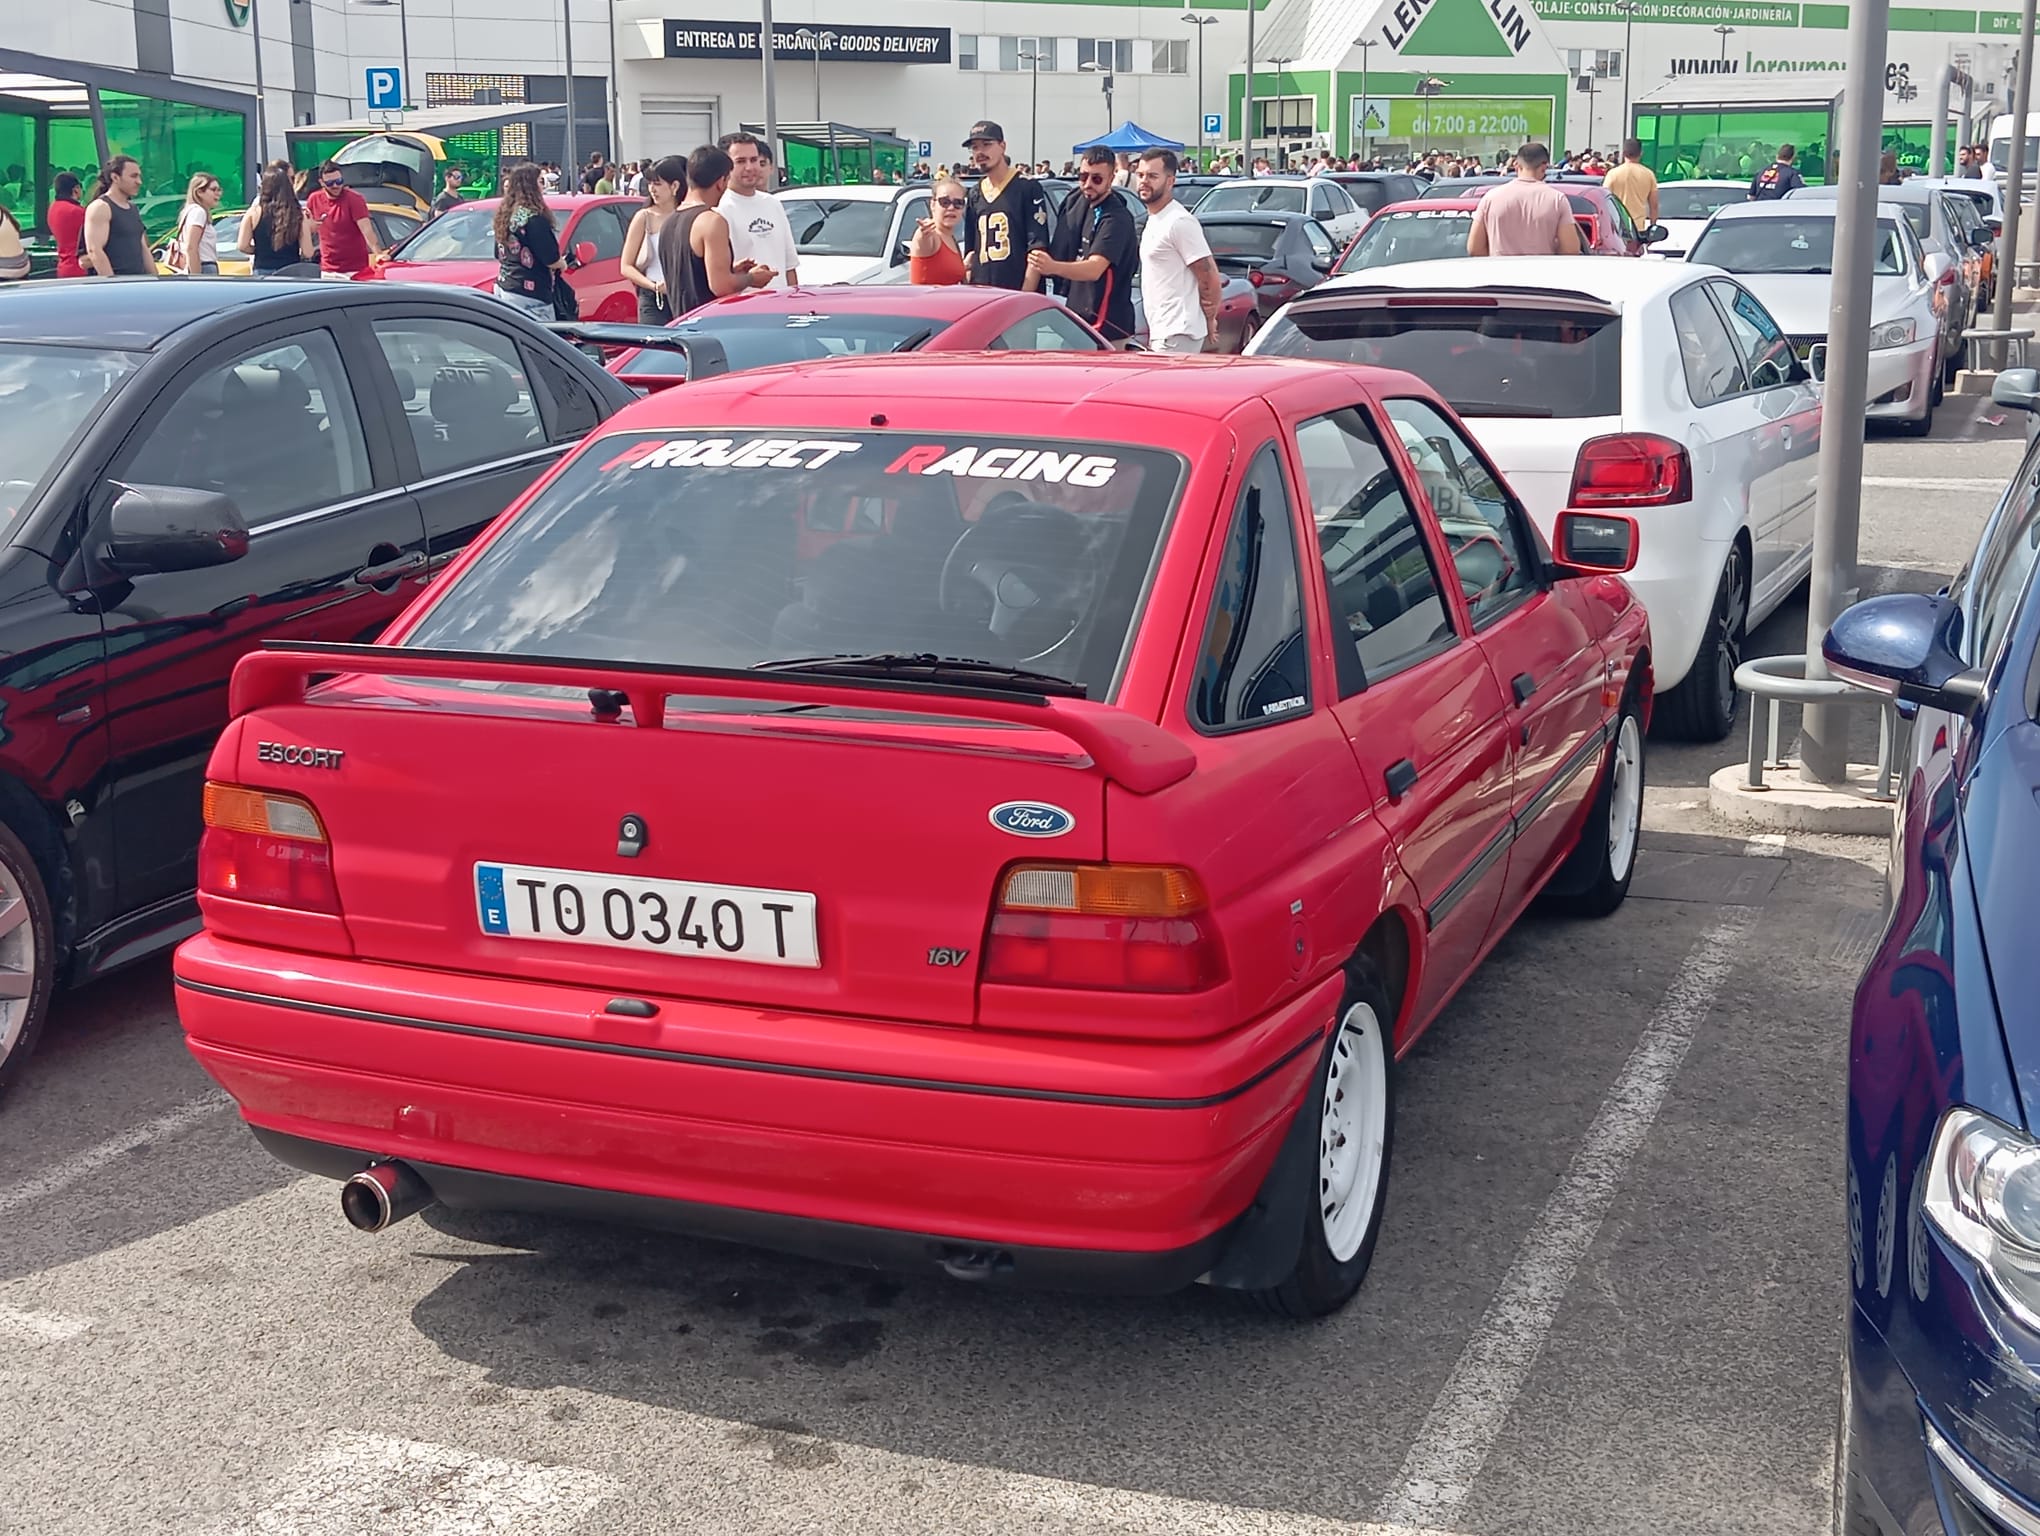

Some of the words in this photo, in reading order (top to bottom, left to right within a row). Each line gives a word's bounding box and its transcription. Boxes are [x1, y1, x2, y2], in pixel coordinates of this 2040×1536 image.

[676, 31, 736, 48] ENTREGA
[739, 32, 756, 48] DE
[840, 35, 881, 52] GOODS
[883, 36, 939, 53] DELIVERY
[372, 72, 394, 105] P
[1207, 116, 1218, 131] P
[1434, 115, 1465, 133] 7:00
[1467, 119, 1476, 133] a
[1480, 115, 1528, 133] 22:00h
[1416, 210, 1474, 219] SUBA
[978, 212, 1011, 264] 13
[600, 438, 863, 472] PROJECT
[884, 444, 1118, 488] RACING
[257, 741, 345, 769] ESCORT
[1008, 807, 1054, 829] Ford
[488, 909, 501, 924] E
[602, 888, 745, 952] 0340
[762, 903, 794, 958] T
[927, 947, 968, 967] 16V
